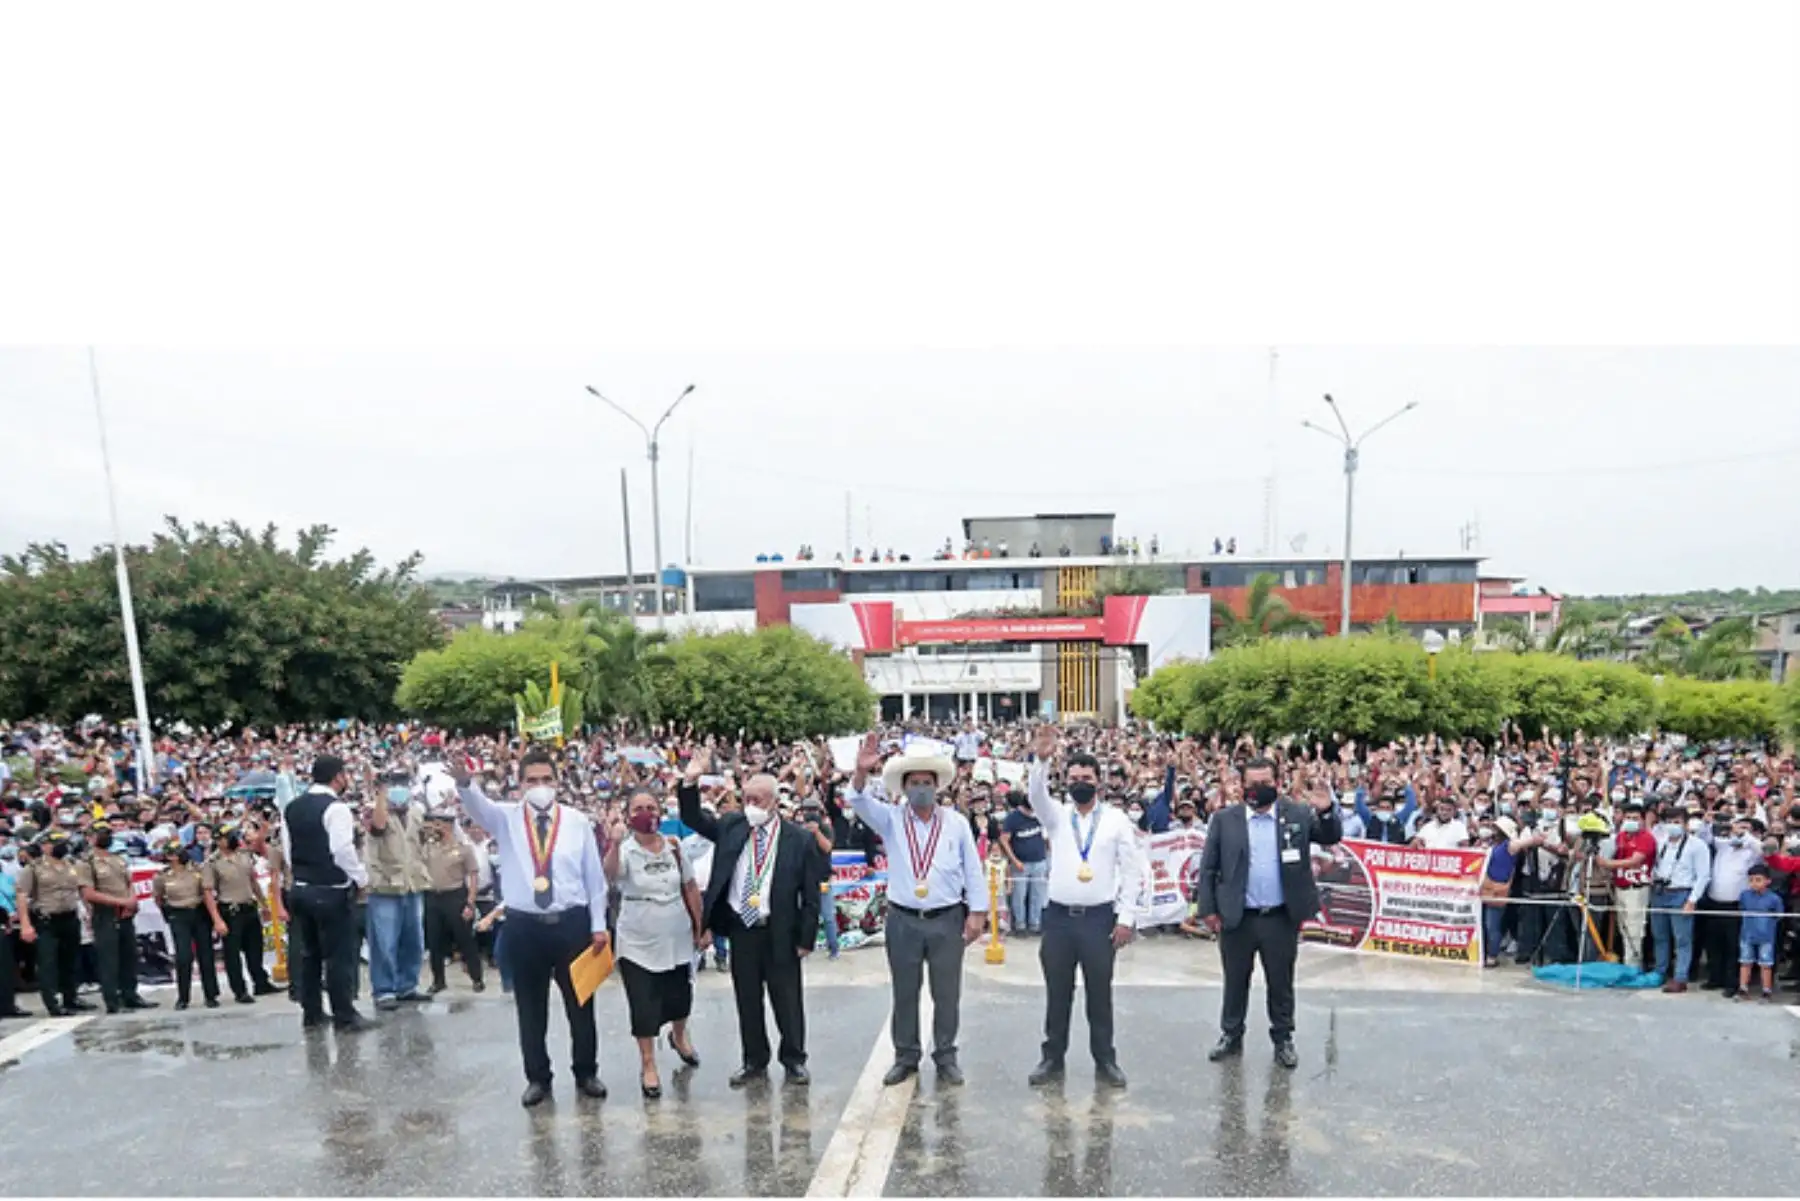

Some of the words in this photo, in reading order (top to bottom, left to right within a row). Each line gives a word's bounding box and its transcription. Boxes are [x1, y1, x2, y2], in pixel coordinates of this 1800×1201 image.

[1364, 848, 1385, 866] POR
[1431, 854, 1462, 873] LIBRE
[1374, 939, 1389, 952] TE
[1391, 941, 1469, 961] RESPALDA
